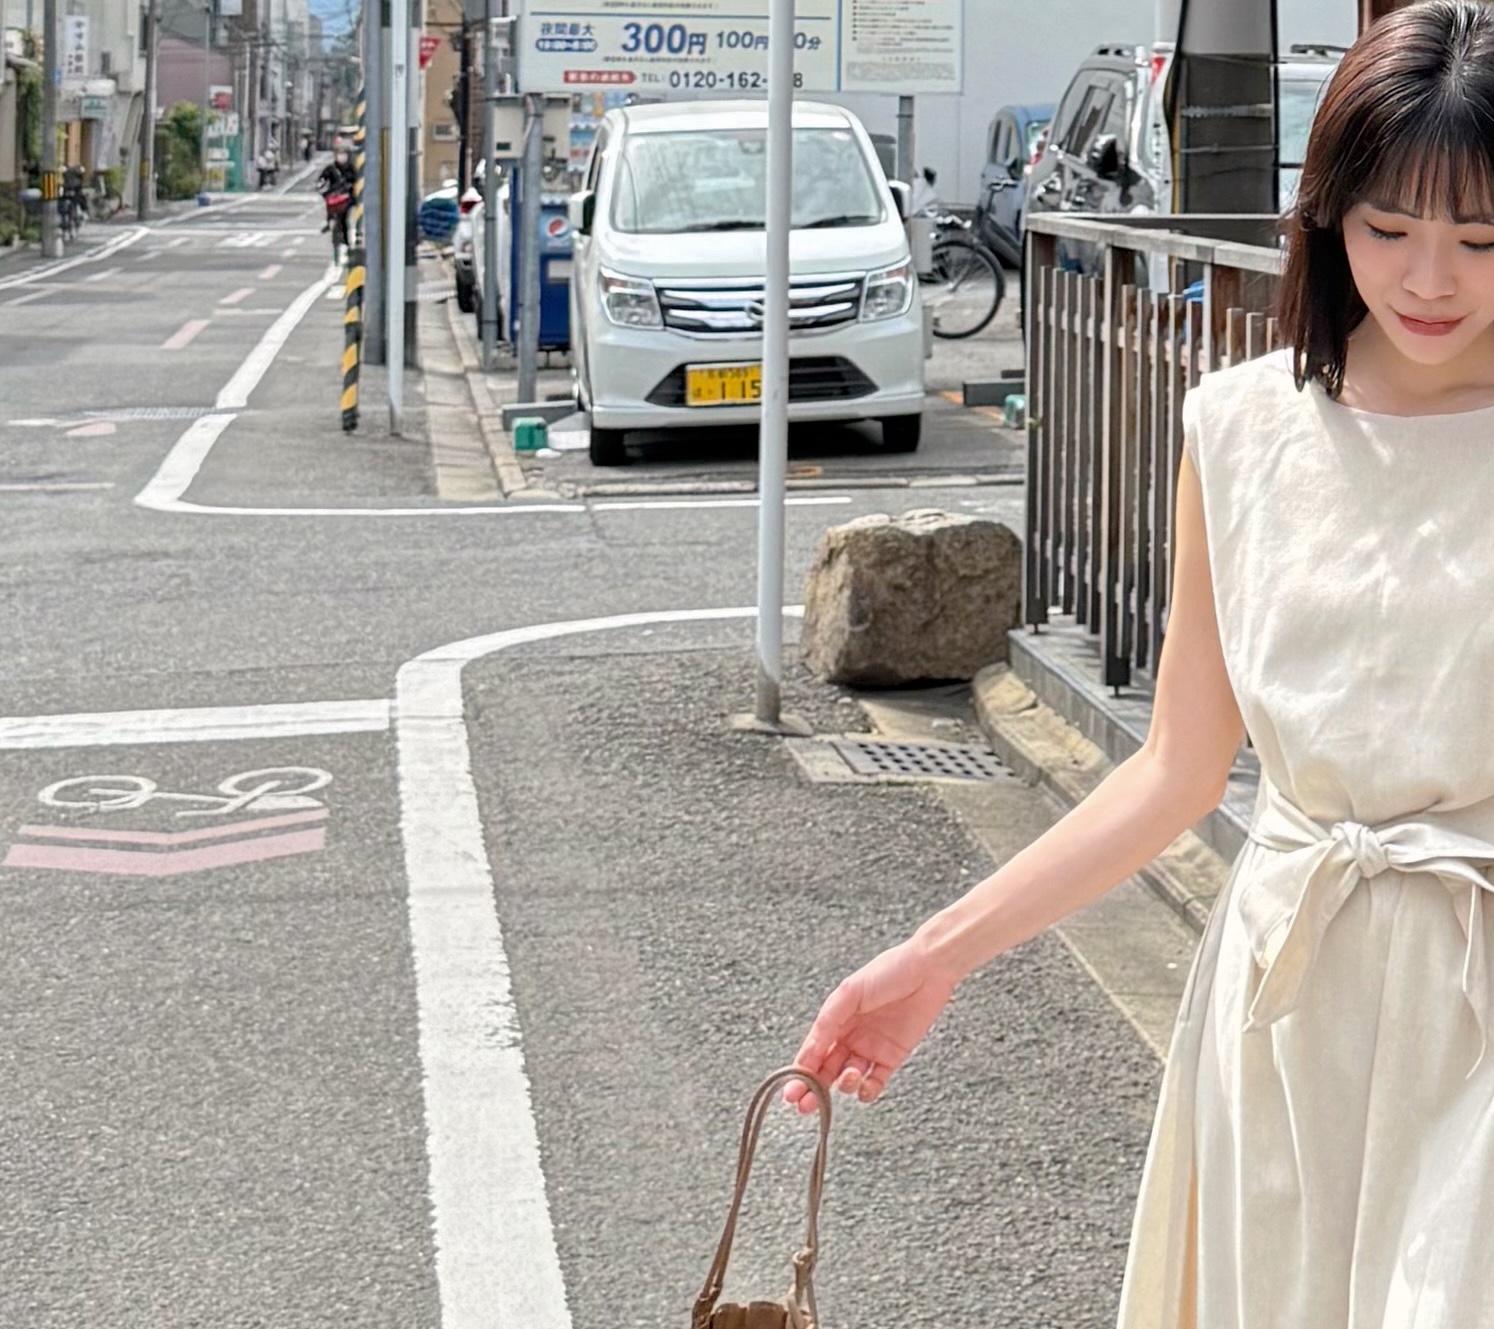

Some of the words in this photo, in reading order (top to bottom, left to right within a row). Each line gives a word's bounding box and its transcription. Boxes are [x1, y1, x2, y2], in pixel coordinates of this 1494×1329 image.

[621, 22, 708, 55] 300円
[793, 32, 822, 50] 0分
[669, 70, 803, 88] 0120-162-8
